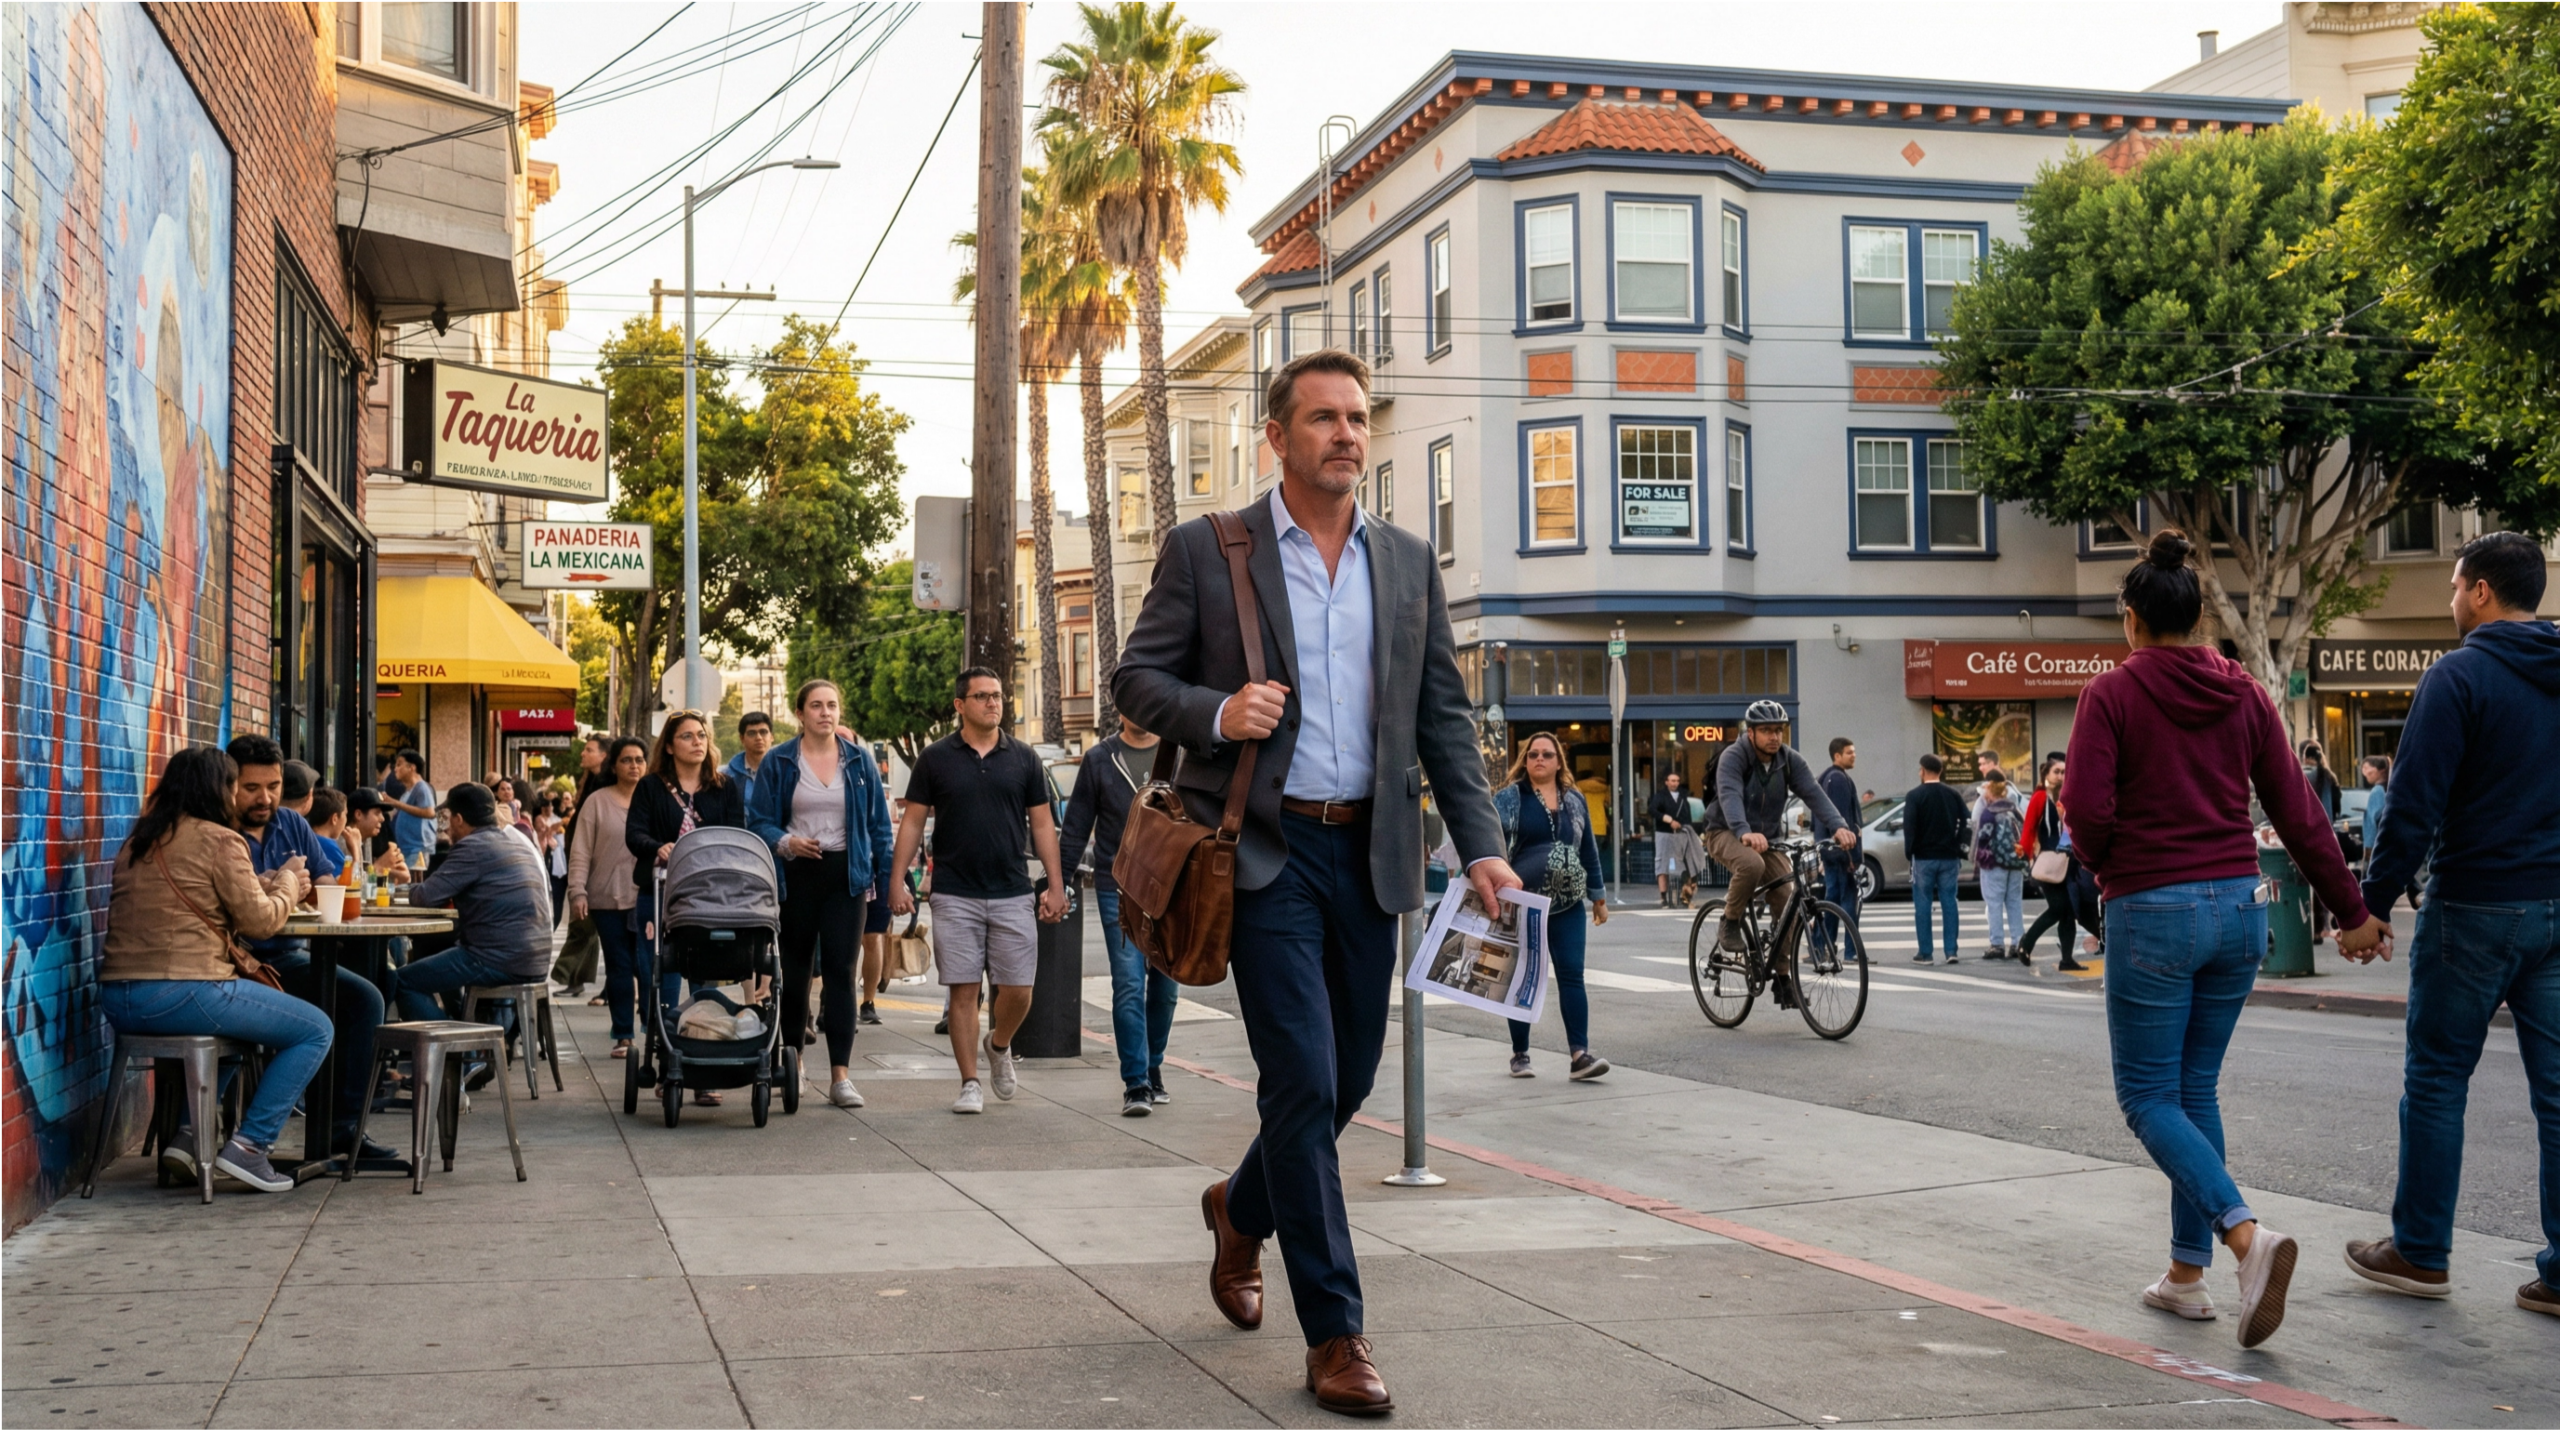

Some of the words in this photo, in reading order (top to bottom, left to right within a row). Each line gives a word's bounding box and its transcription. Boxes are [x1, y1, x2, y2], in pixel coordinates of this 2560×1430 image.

[505, 382, 536, 414] La
[442, 390, 602, 463] Taqueria
[1625, 486, 1651, 499] FOR
[1654, 487, 1686, 499] SALE
[534, 528, 641, 549] PANADERIA
[530, 551, 552, 568] LA
[558, 551, 645, 570] MEXICANA
[378, 664, 447, 677] QUERIA
[1966, 651, 2018, 674] Café
[2024, 652, 2115, 674] Corazón
[2373, 649, 2452, 671] CORAZO
[1684, 726, 1723, 741] OPEN
